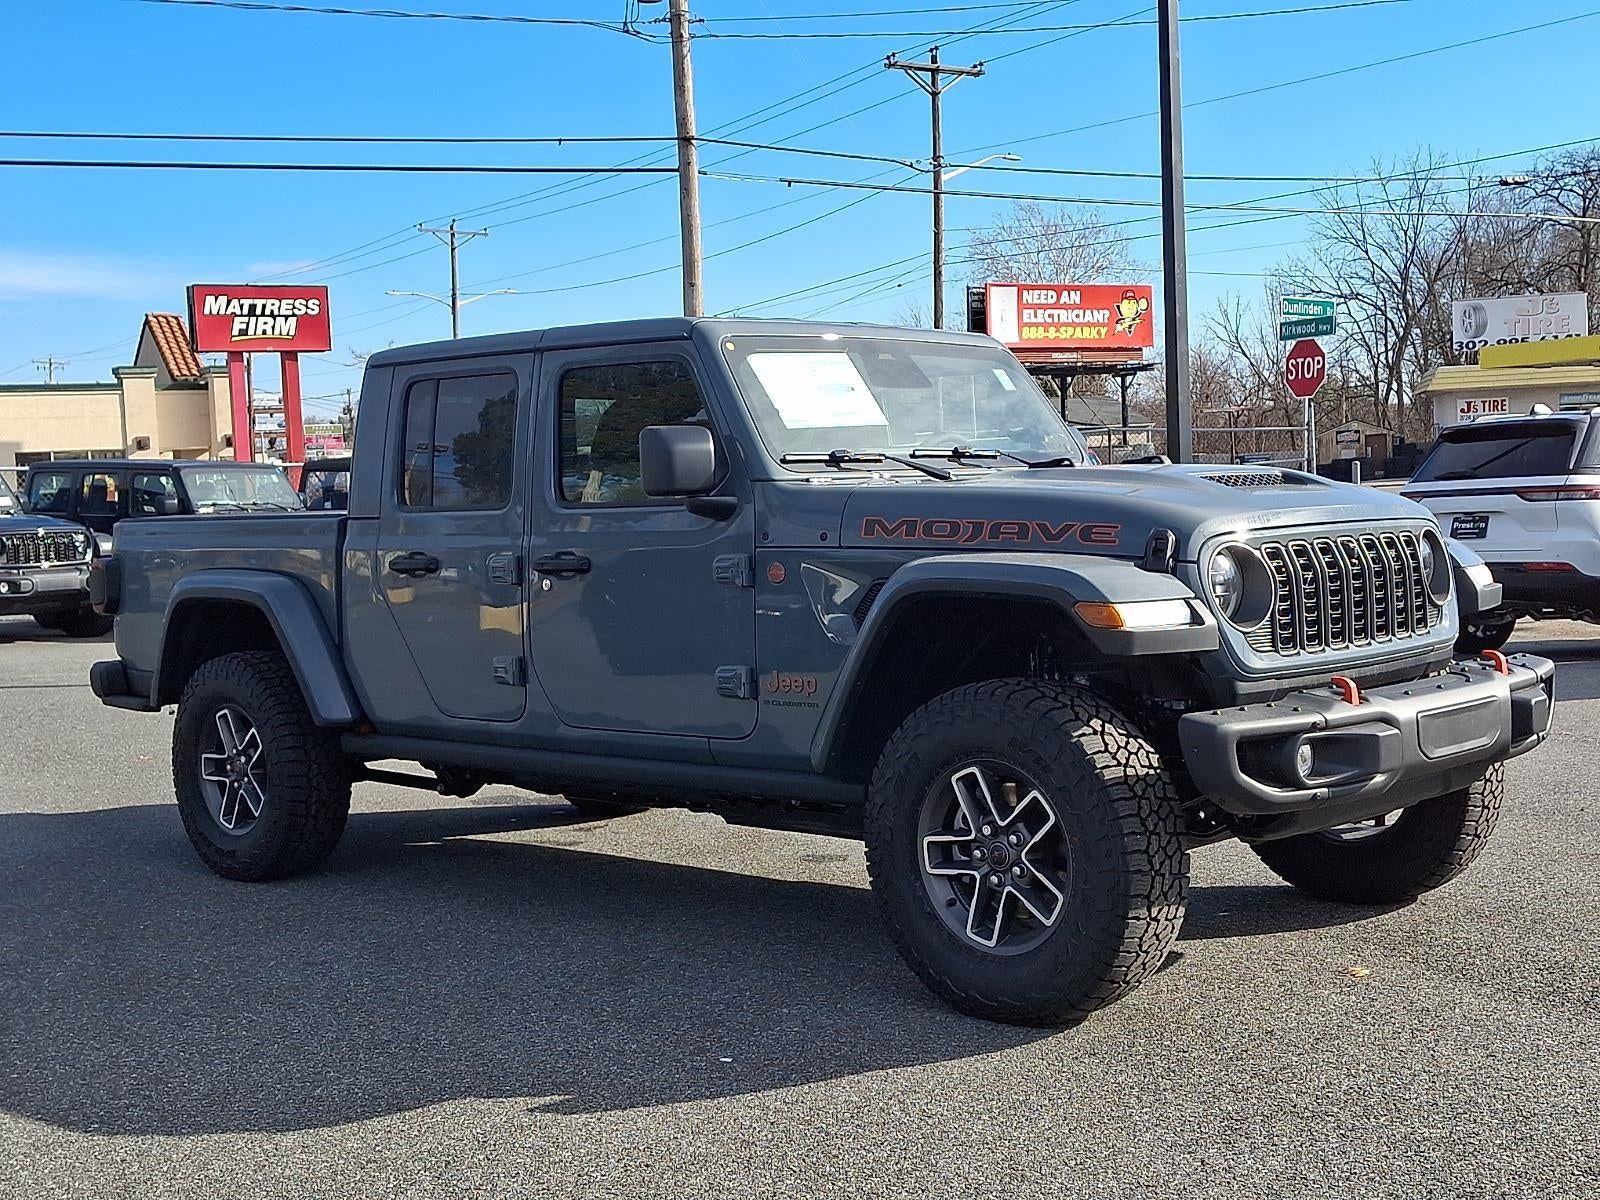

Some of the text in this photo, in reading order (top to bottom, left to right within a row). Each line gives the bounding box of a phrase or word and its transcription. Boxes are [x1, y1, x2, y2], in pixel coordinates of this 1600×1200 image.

[203, 294, 321, 316] MATTRESS
[1021, 289, 1082, 305] NEED AN
[1022, 308, 1111, 324] ELECTRICIAN?
[1283, 300, 1323, 316] Dunlinden
[231, 316, 298, 337] FIRM
[1021, 325, 1109, 340] 888-8-SPARKY
[1281, 321, 1316, 336] Kirkwood
[1503, 314, 1571, 337] TIRE
[1287, 356, 1323, 380] STOP
[1460, 399, 1507, 414] J's TIRE
[861, 516, 1121, 546] MOJAVE
[767, 670, 818, 697] Jeep
